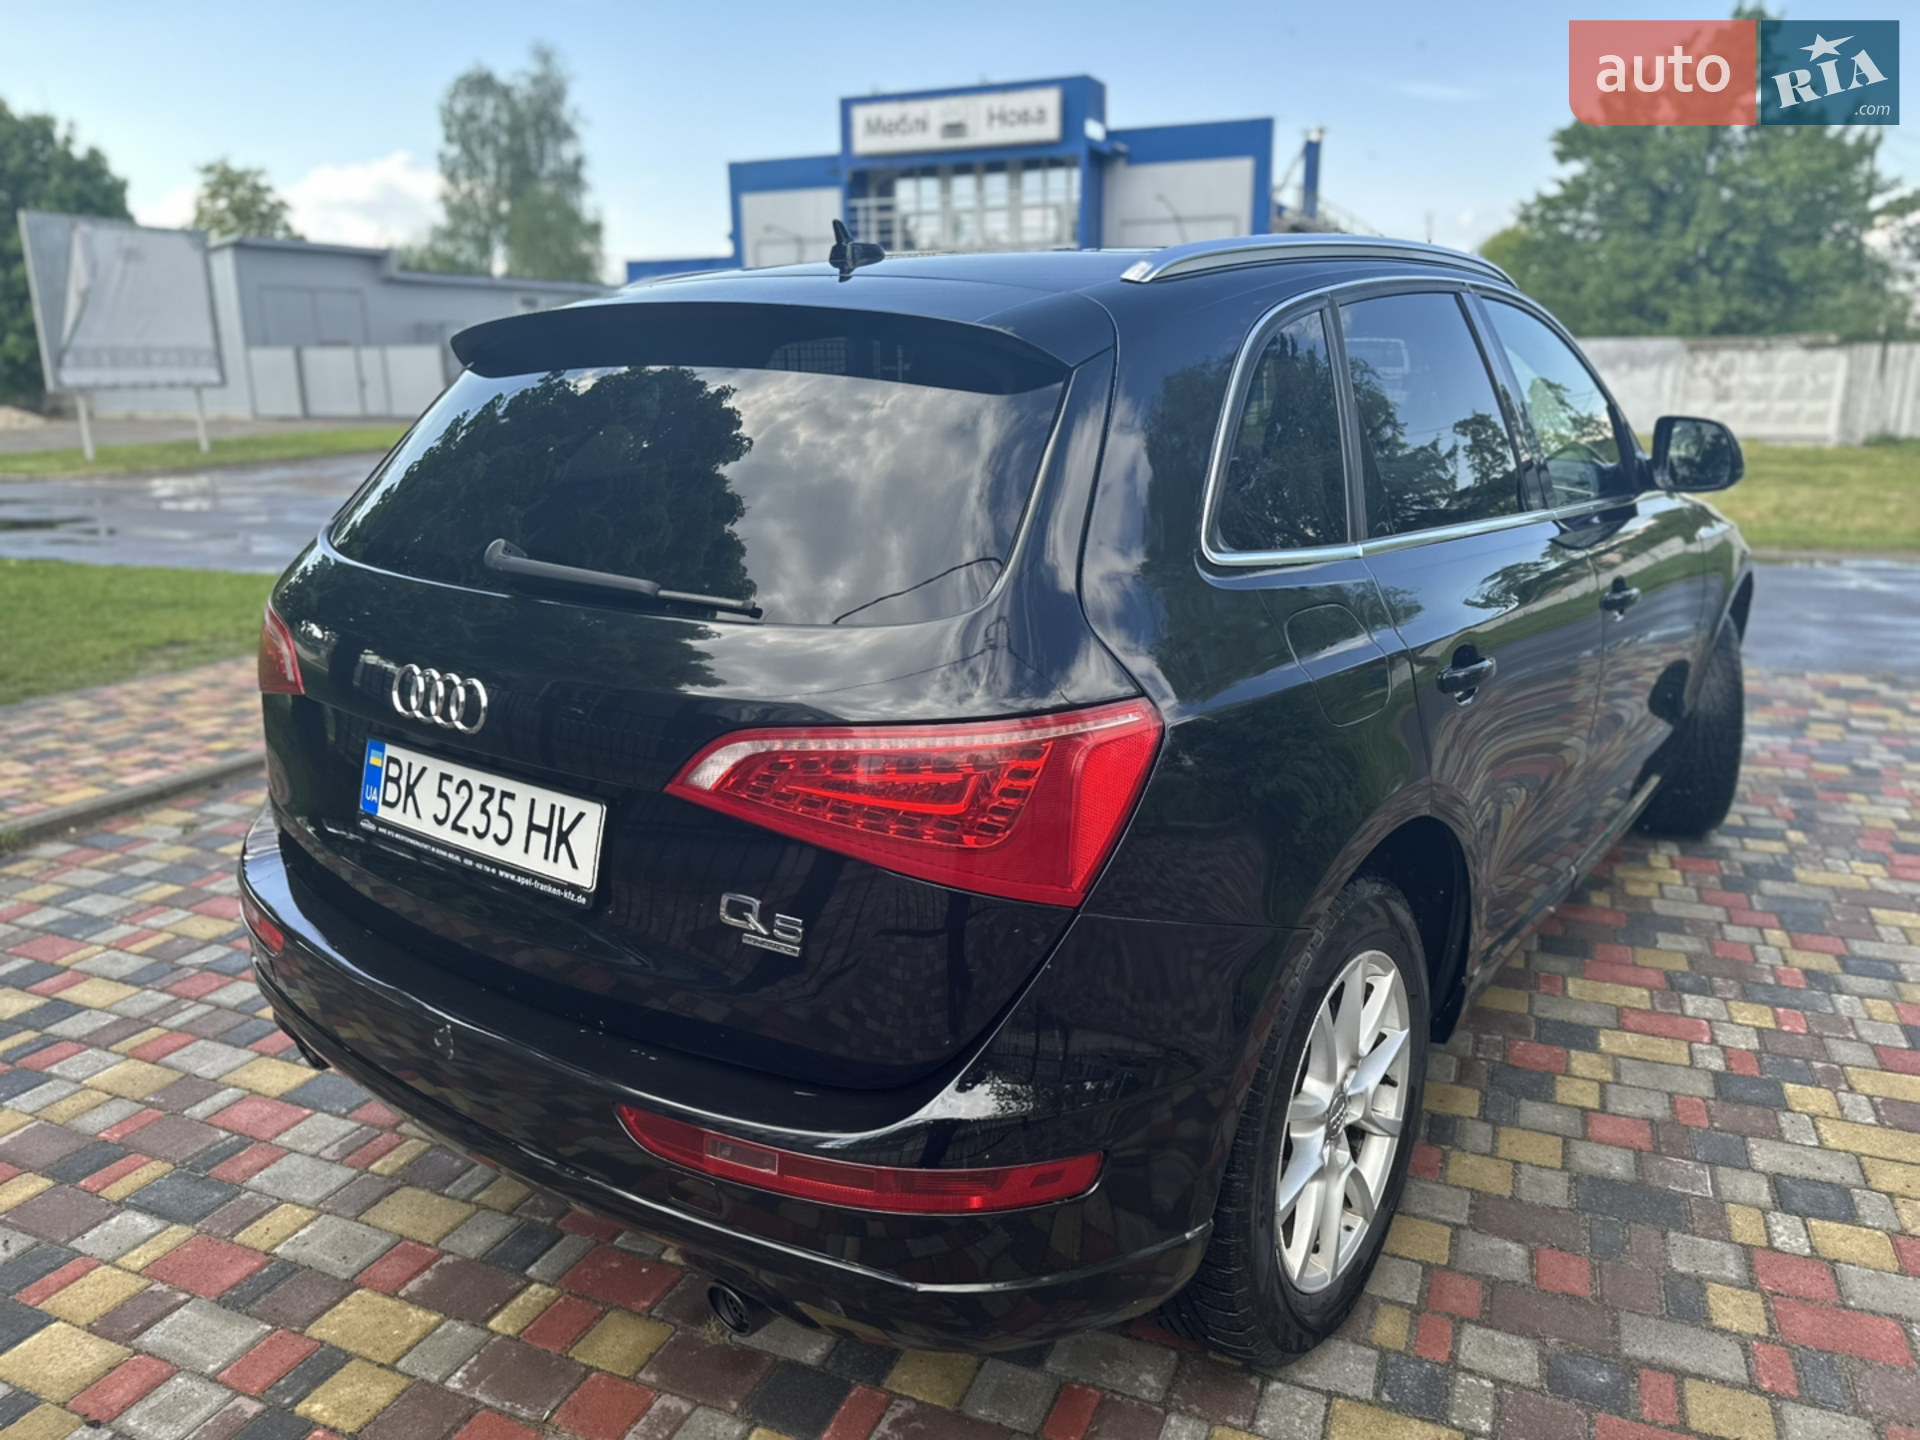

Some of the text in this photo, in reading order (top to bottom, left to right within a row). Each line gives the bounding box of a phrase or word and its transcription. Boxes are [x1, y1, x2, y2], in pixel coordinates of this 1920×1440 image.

[986, 105, 1047, 129] Нова
[365, 784, 378, 804] UA
[381, 755, 428, 820] BK
[432, 771, 517, 847] 5235
[523, 797, 587, 871] HK
[719, 892, 803, 944] Q5
